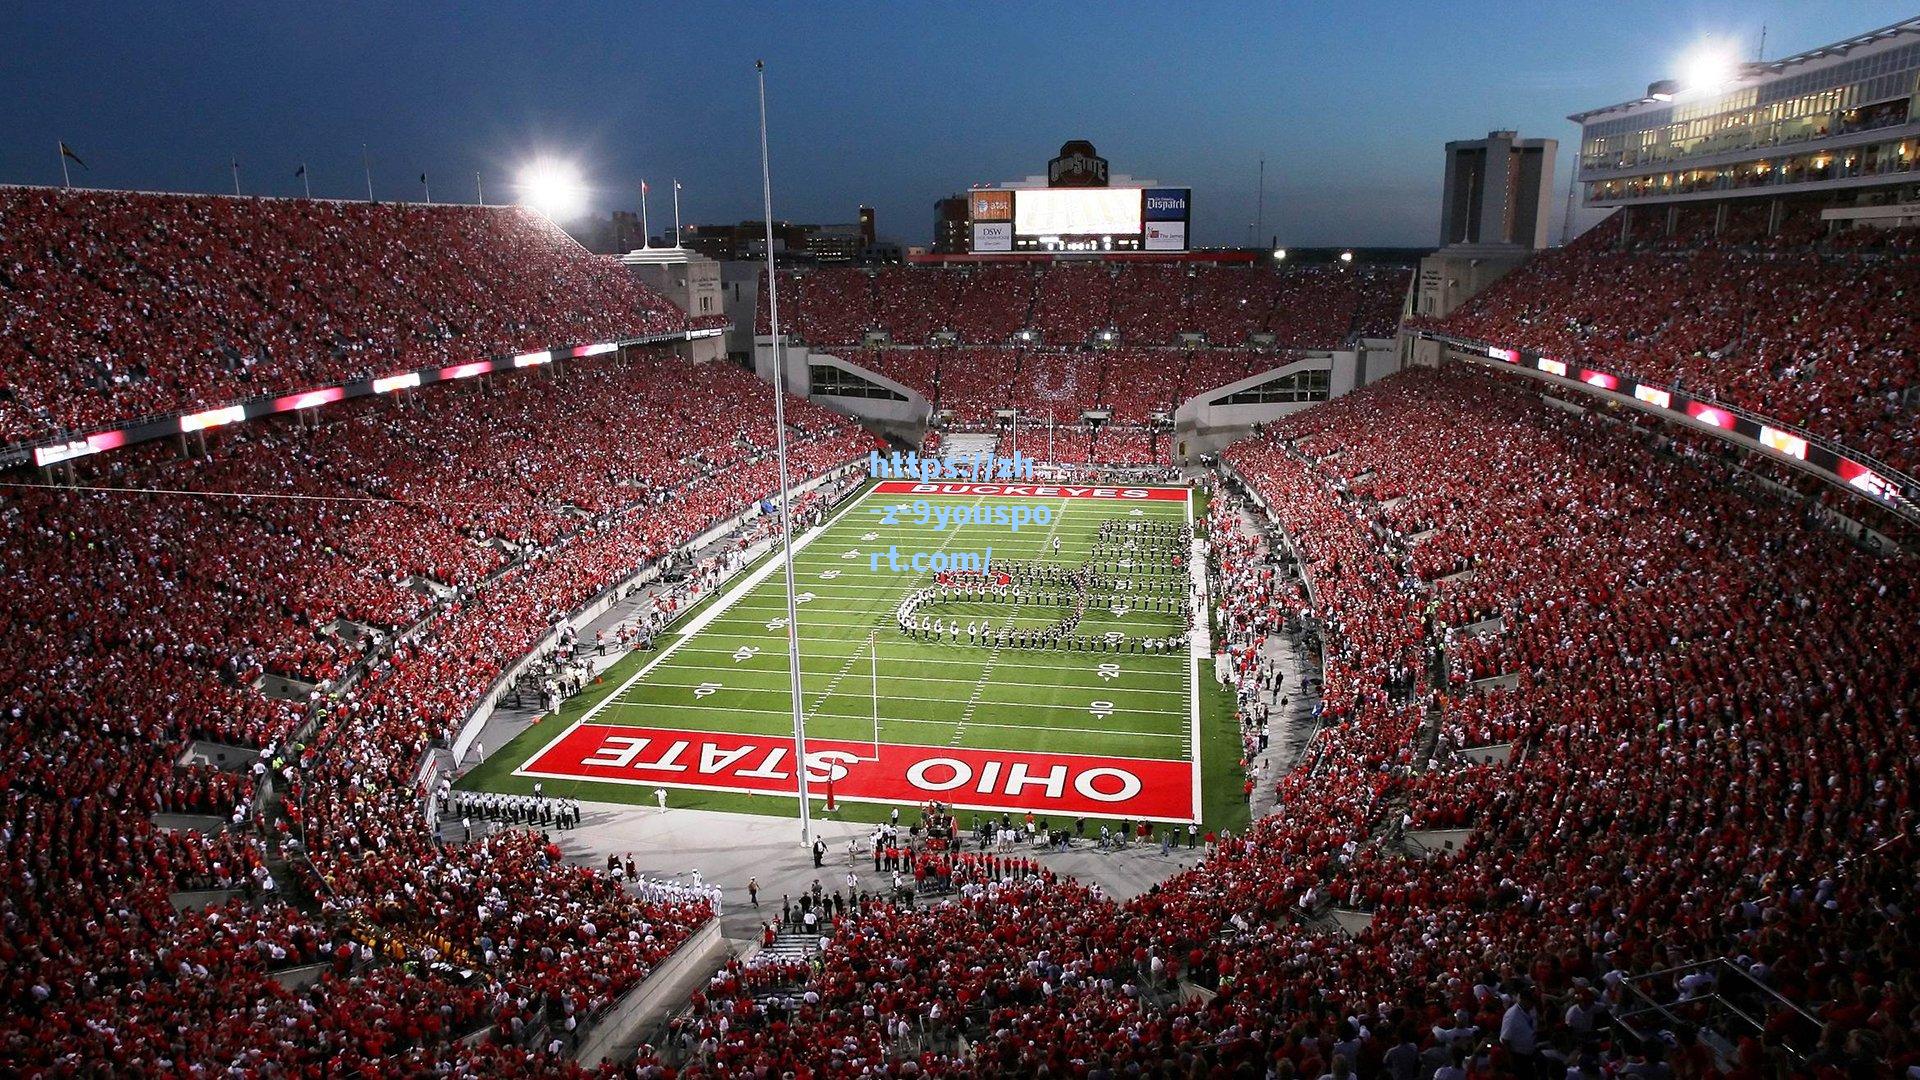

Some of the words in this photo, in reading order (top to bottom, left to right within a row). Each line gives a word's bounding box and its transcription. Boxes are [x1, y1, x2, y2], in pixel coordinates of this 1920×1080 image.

[1147, 197, 1185, 211] Dispatch
[983, 228, 1002, 236] DSW
[910, 484, 1150, 499] BUCKEYES
[733, 645, 760, 660] 20
[1097, 663, 1120, 678] 20
[694, 682, 723, 696] 10
[1089, 701, 1114, 715] 10
[580, 736, 860, 783] STATE
[905, 757, 1143, 803] OHIO
